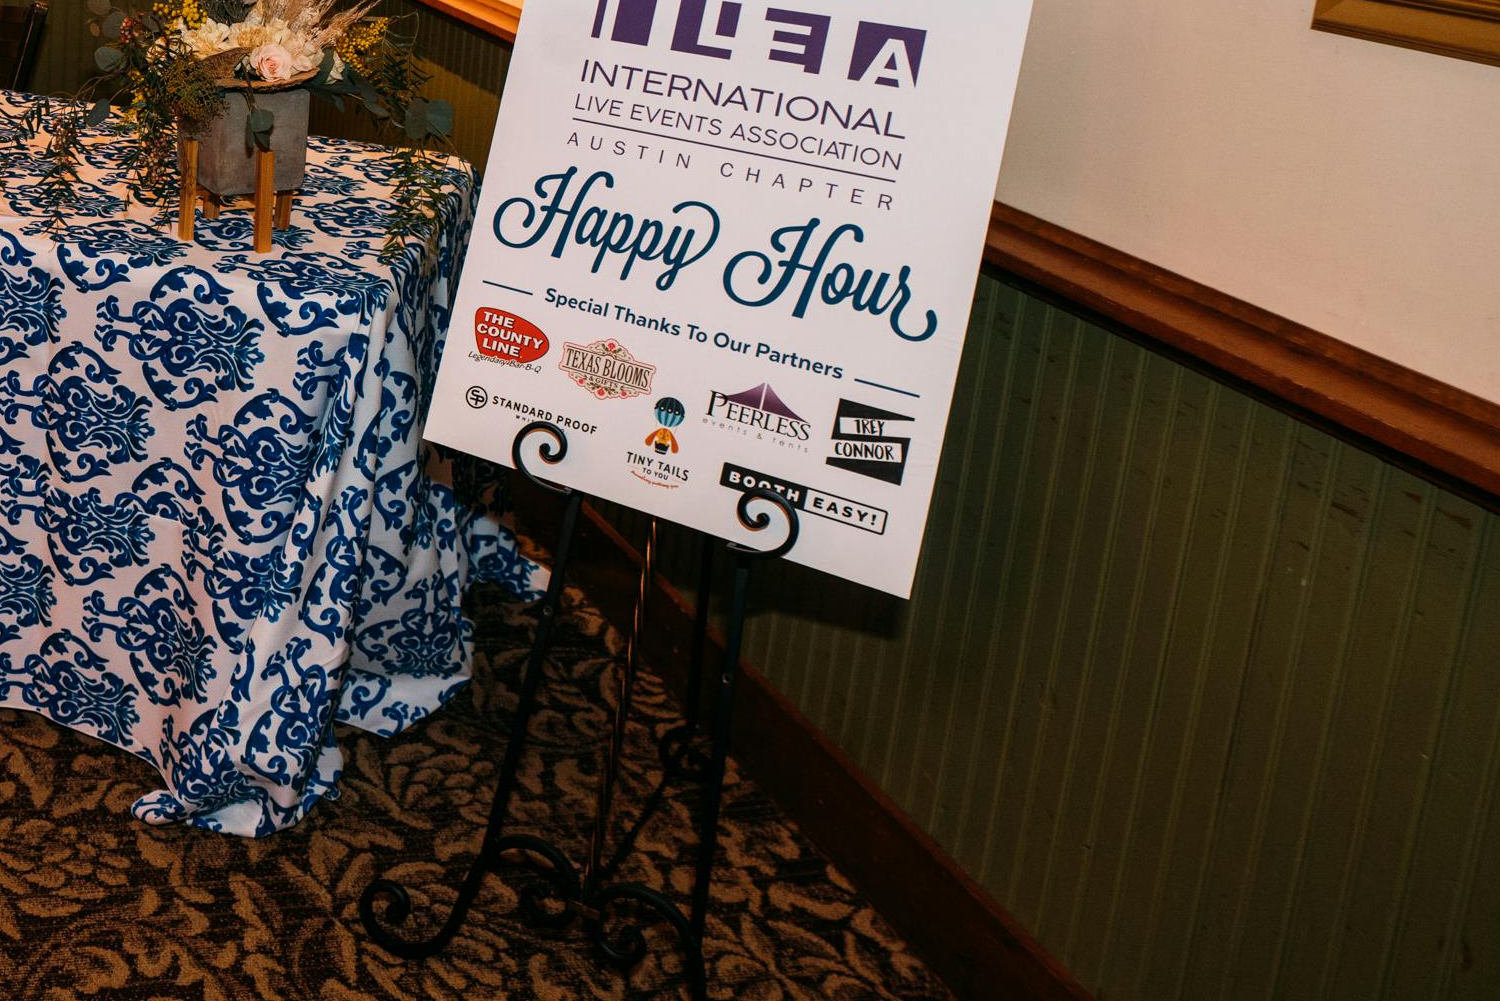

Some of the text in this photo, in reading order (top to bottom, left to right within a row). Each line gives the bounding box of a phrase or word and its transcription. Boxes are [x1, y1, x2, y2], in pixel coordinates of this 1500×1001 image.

[581, 59, 905, 139] INTERNATIONAL
[575, 93, 902, 170] LIVE EVENTS ASSOCIATION
[567, 132, 893, 210] AUSTIN CHAPTER
[492, 165, 938, 342] Happy Hour
[483, 311, 515, 329] THE
[545, 288, 843, 379] Special Thanks To Our Partners
[476, 323, 544, 350] COUNTY
[482, 338, 520, 358] LINE
[565, 348, 650, 388] TEXAS BLOOMS
[595, 377, 618, 389] GIFTS
[492, 395, 598, 435] STANDARD PROOF
[706, 389, 812, 441] PEERLESS
[854, 419, 885, 436] TREY
[702, 418, 748, 436] events
[772, 437, 808, 453] tents
[834, 441, 894, 461] CONNOR
[626, 451, 654, 467] TINY
[658, 461, 689, 481] TAILS
[642, 467, 652, 475] TO
[654, 471, 669, 480] YOU
[813, 497, 877, 526] EASY!
